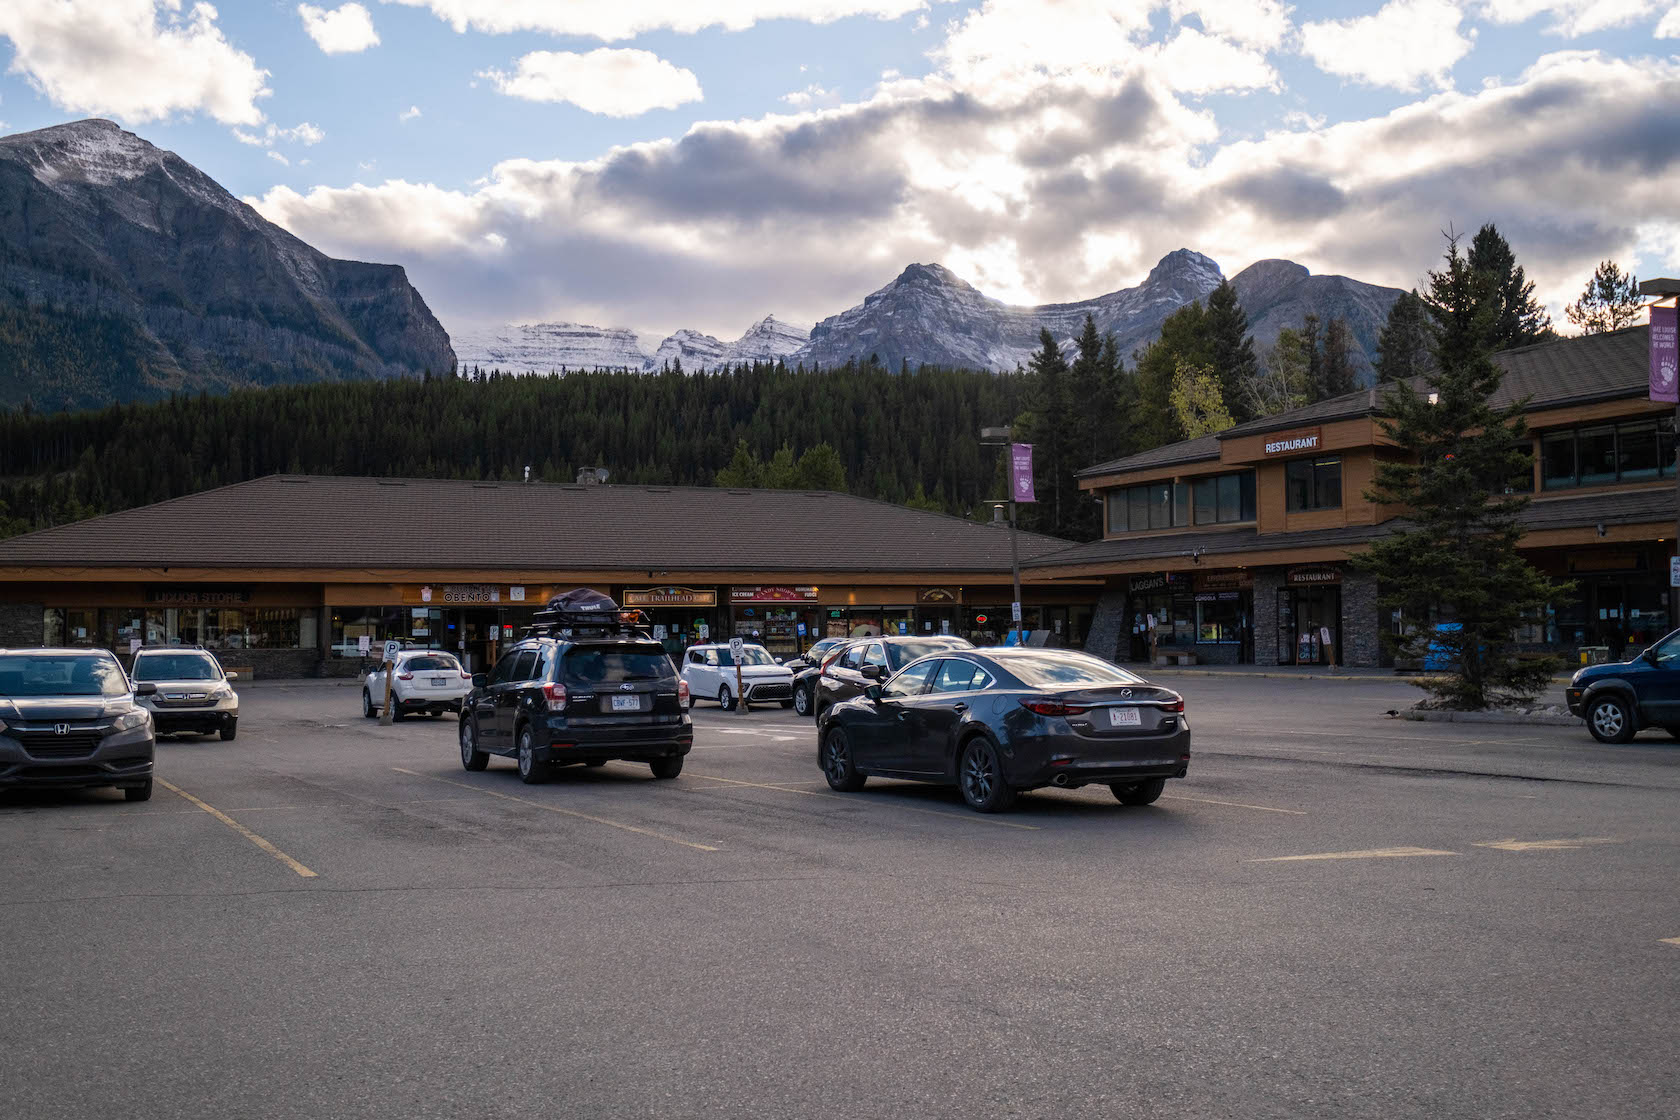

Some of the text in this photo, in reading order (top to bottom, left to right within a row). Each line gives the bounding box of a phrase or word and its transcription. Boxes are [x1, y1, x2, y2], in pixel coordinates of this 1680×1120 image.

[1266, 436, 1318, 453] RESTAURANT
[1294, 572, 1335, 582] RESTAURANT
[1131, 577, 1164, 591] LAGGAN'S
[201, 592, 241, 603] STORE
[445, 593, 490, 602] OBENTO
[651, 594, 693, 602] TRAILHEAD
[581, 603, 601, 611] THULE
[389, 644, 396, 652] P
